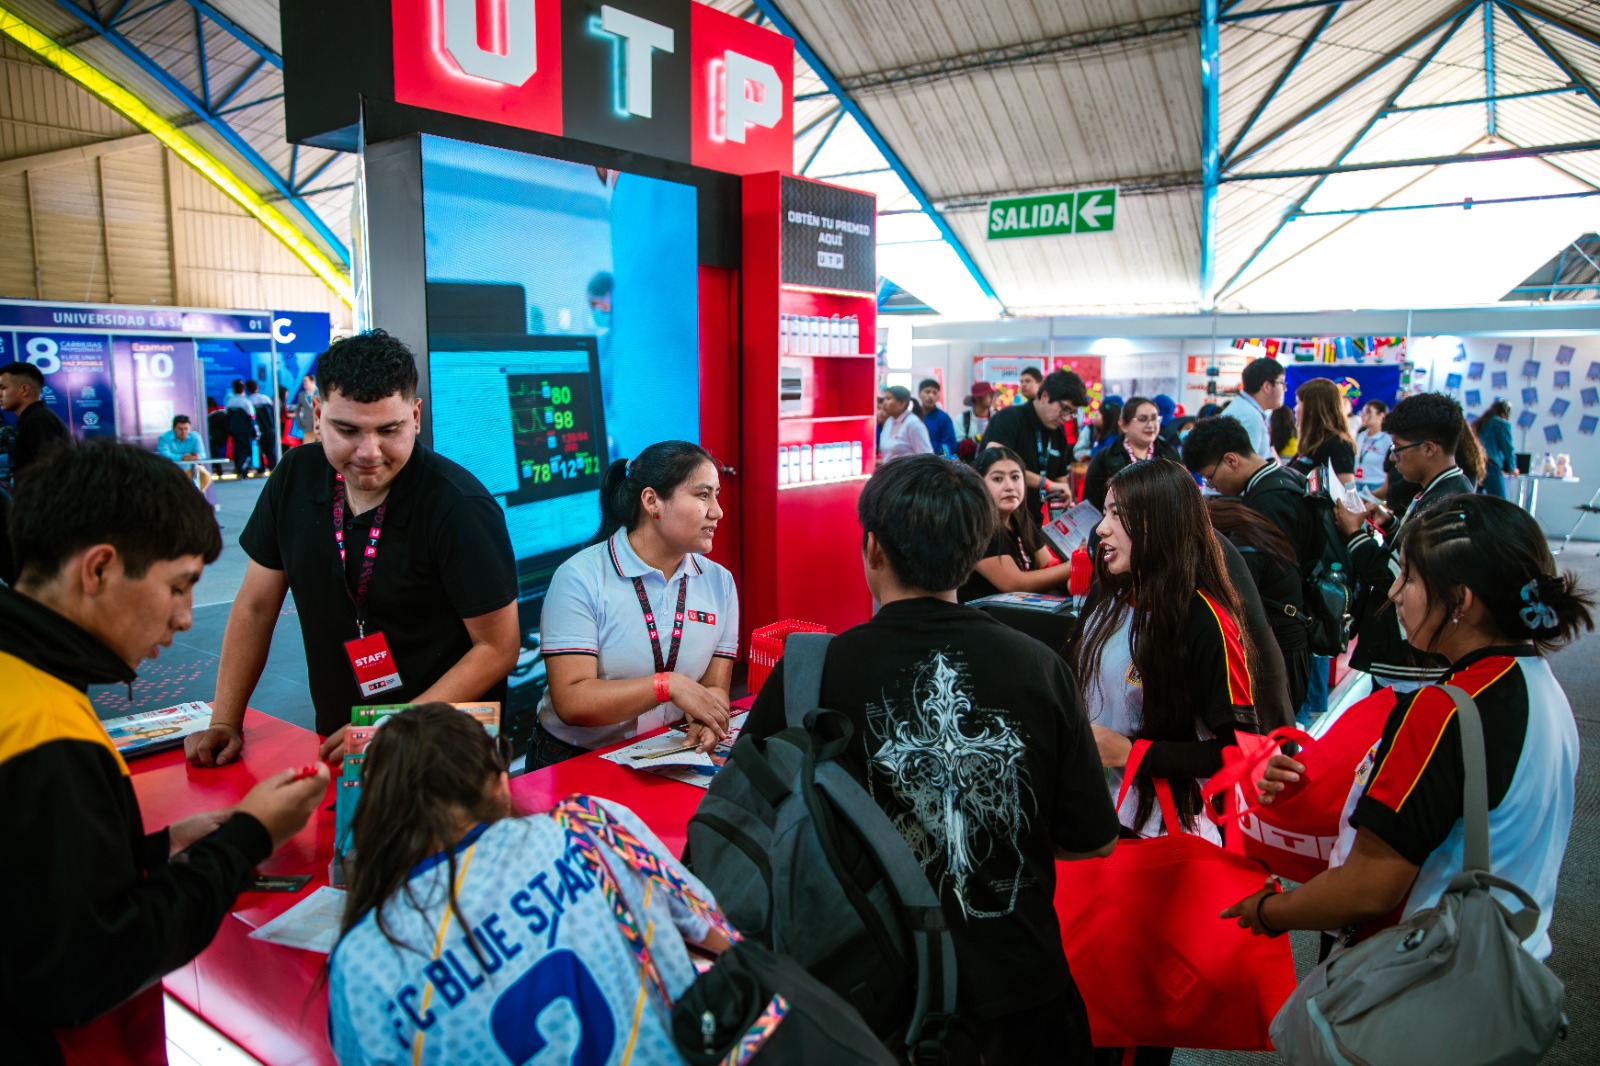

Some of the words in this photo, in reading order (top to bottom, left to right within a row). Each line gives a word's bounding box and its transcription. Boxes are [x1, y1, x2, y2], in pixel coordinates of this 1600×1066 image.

[442, 0, 783, 144] UTP
[787, 210, 820, 228] OBTÉN
[821, 217, 834, 229] TU
[835, 220, 870, 236] PREMIO
[990, 202, 1070, 232] SALIDA
[818, 233, 843, 246] AQUÍ
[818, 254, 843, 267] UTP
[53, 312, 145, 327] UNIVERSIDAD
[150, 315, 166, 328] LA
[249, 320, 263, 330] 01
[26, 337, 62, 375] 8
[132, 343, 174, 352] Examen
[133, 353, 174, 378] 10
[551, 386, 571, 405] 80
[554, 410, 574, 430] 98
[532, 463, 551, 484] 78
[560, 459, 577, 479] 12
[366, 529, 380, 556] UTP
[646, 613, 657, 639] UTP
[673, 613, 684, 637] UTP
[688, 611, 715, 623] UTP
[355, 650, 387, 667] STAFF
[1235, 782, 1338, 861] UT
[422, 912, 523, 1009] BLUE
